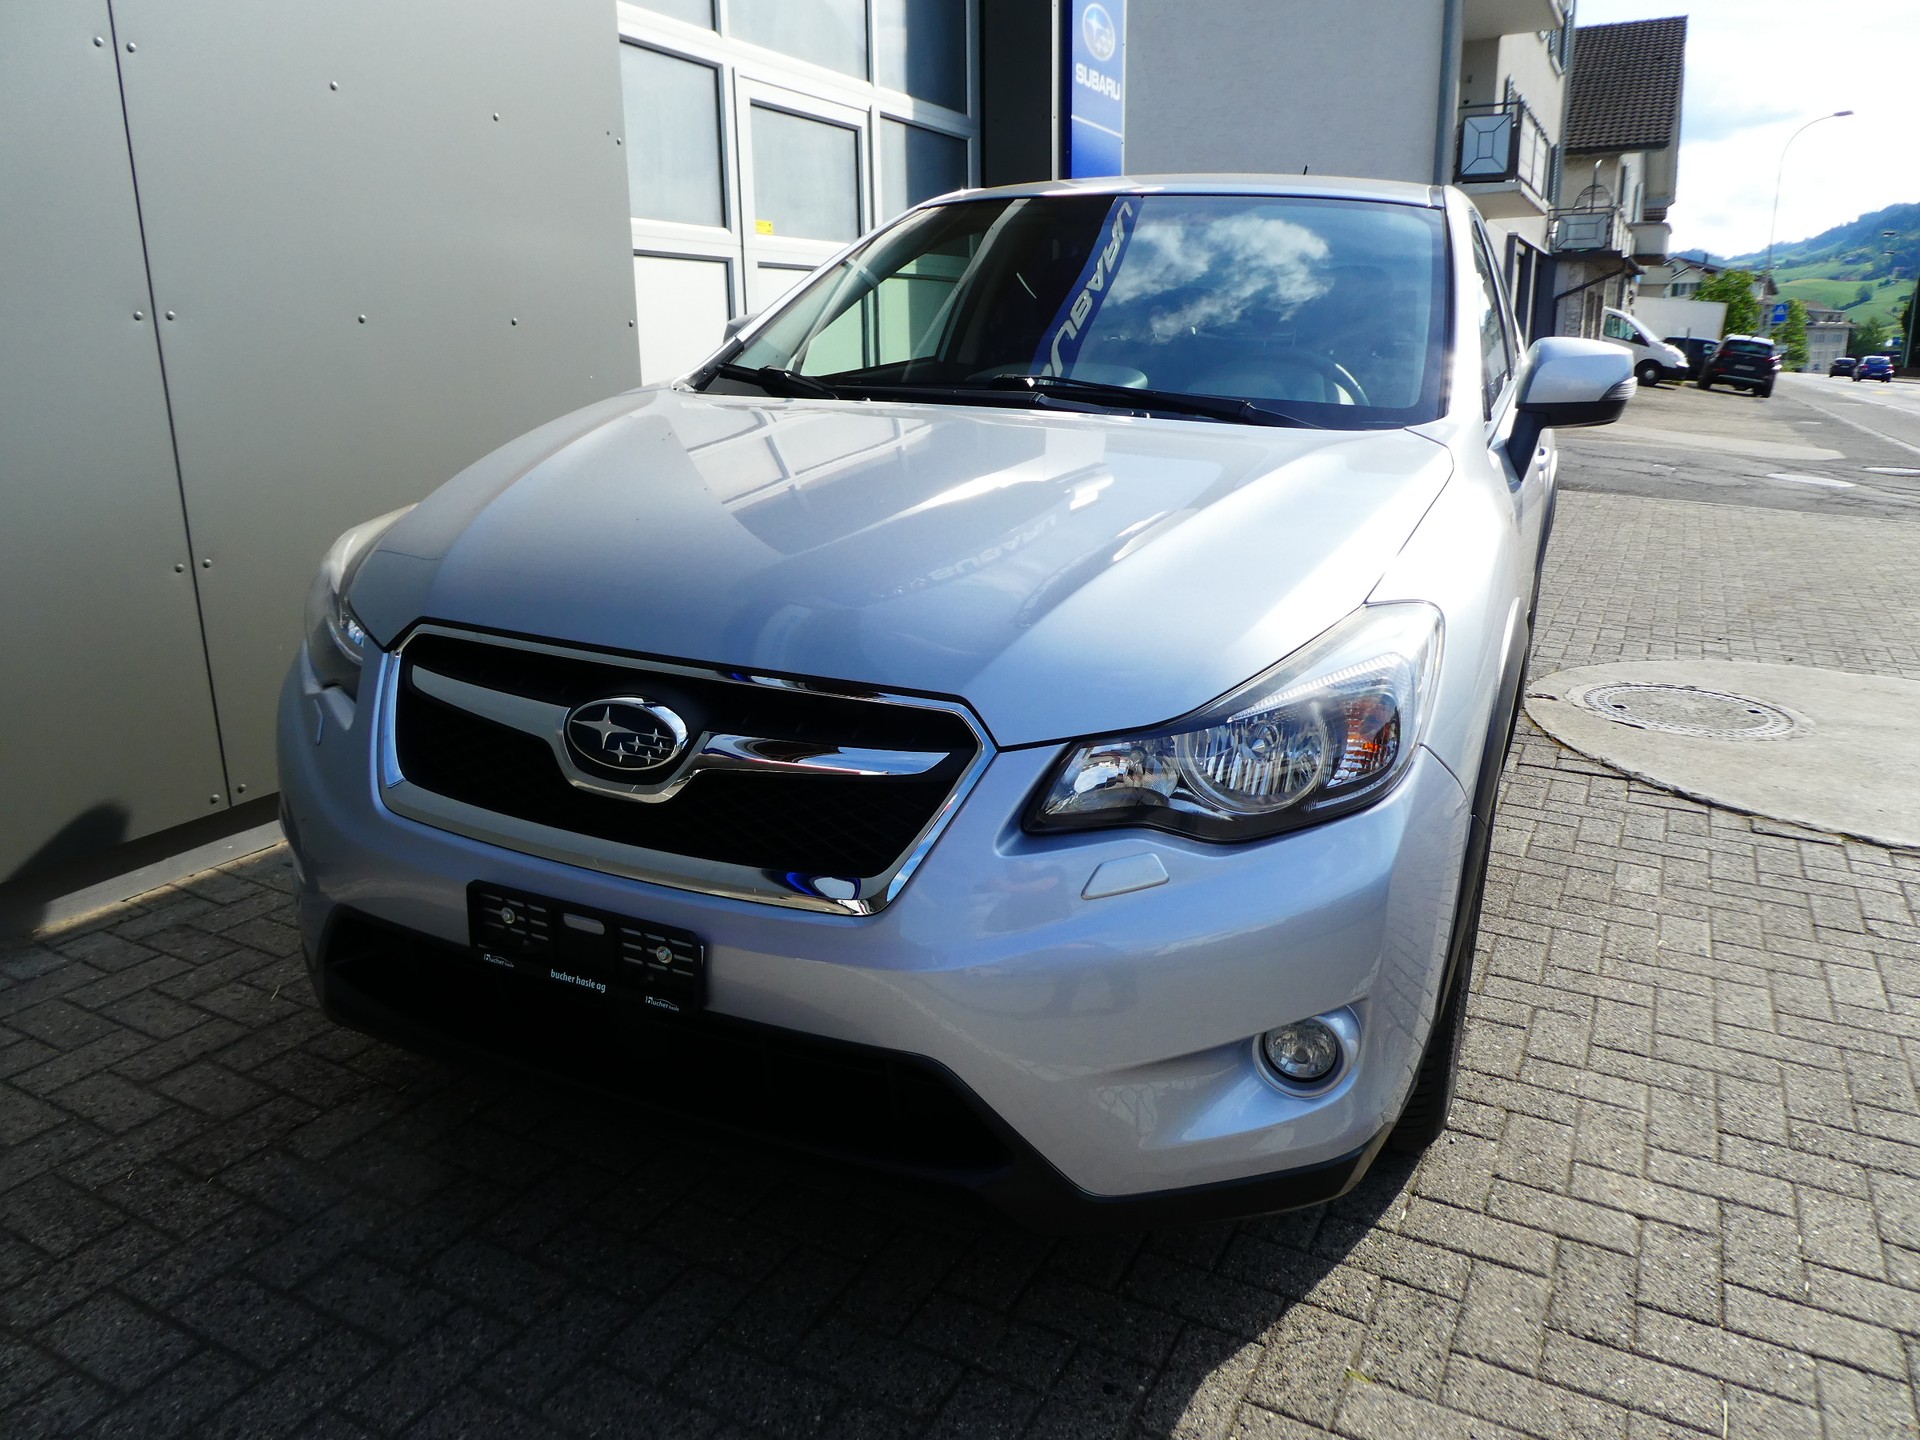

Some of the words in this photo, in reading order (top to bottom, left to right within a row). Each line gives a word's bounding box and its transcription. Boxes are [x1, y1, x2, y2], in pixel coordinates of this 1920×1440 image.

[1075, 63, 1121, 101] SUBARU
[550, 968, 575, 983] bucher
[576, 975, 596, 989] hasle
[596, 982, 606, 993] ag
